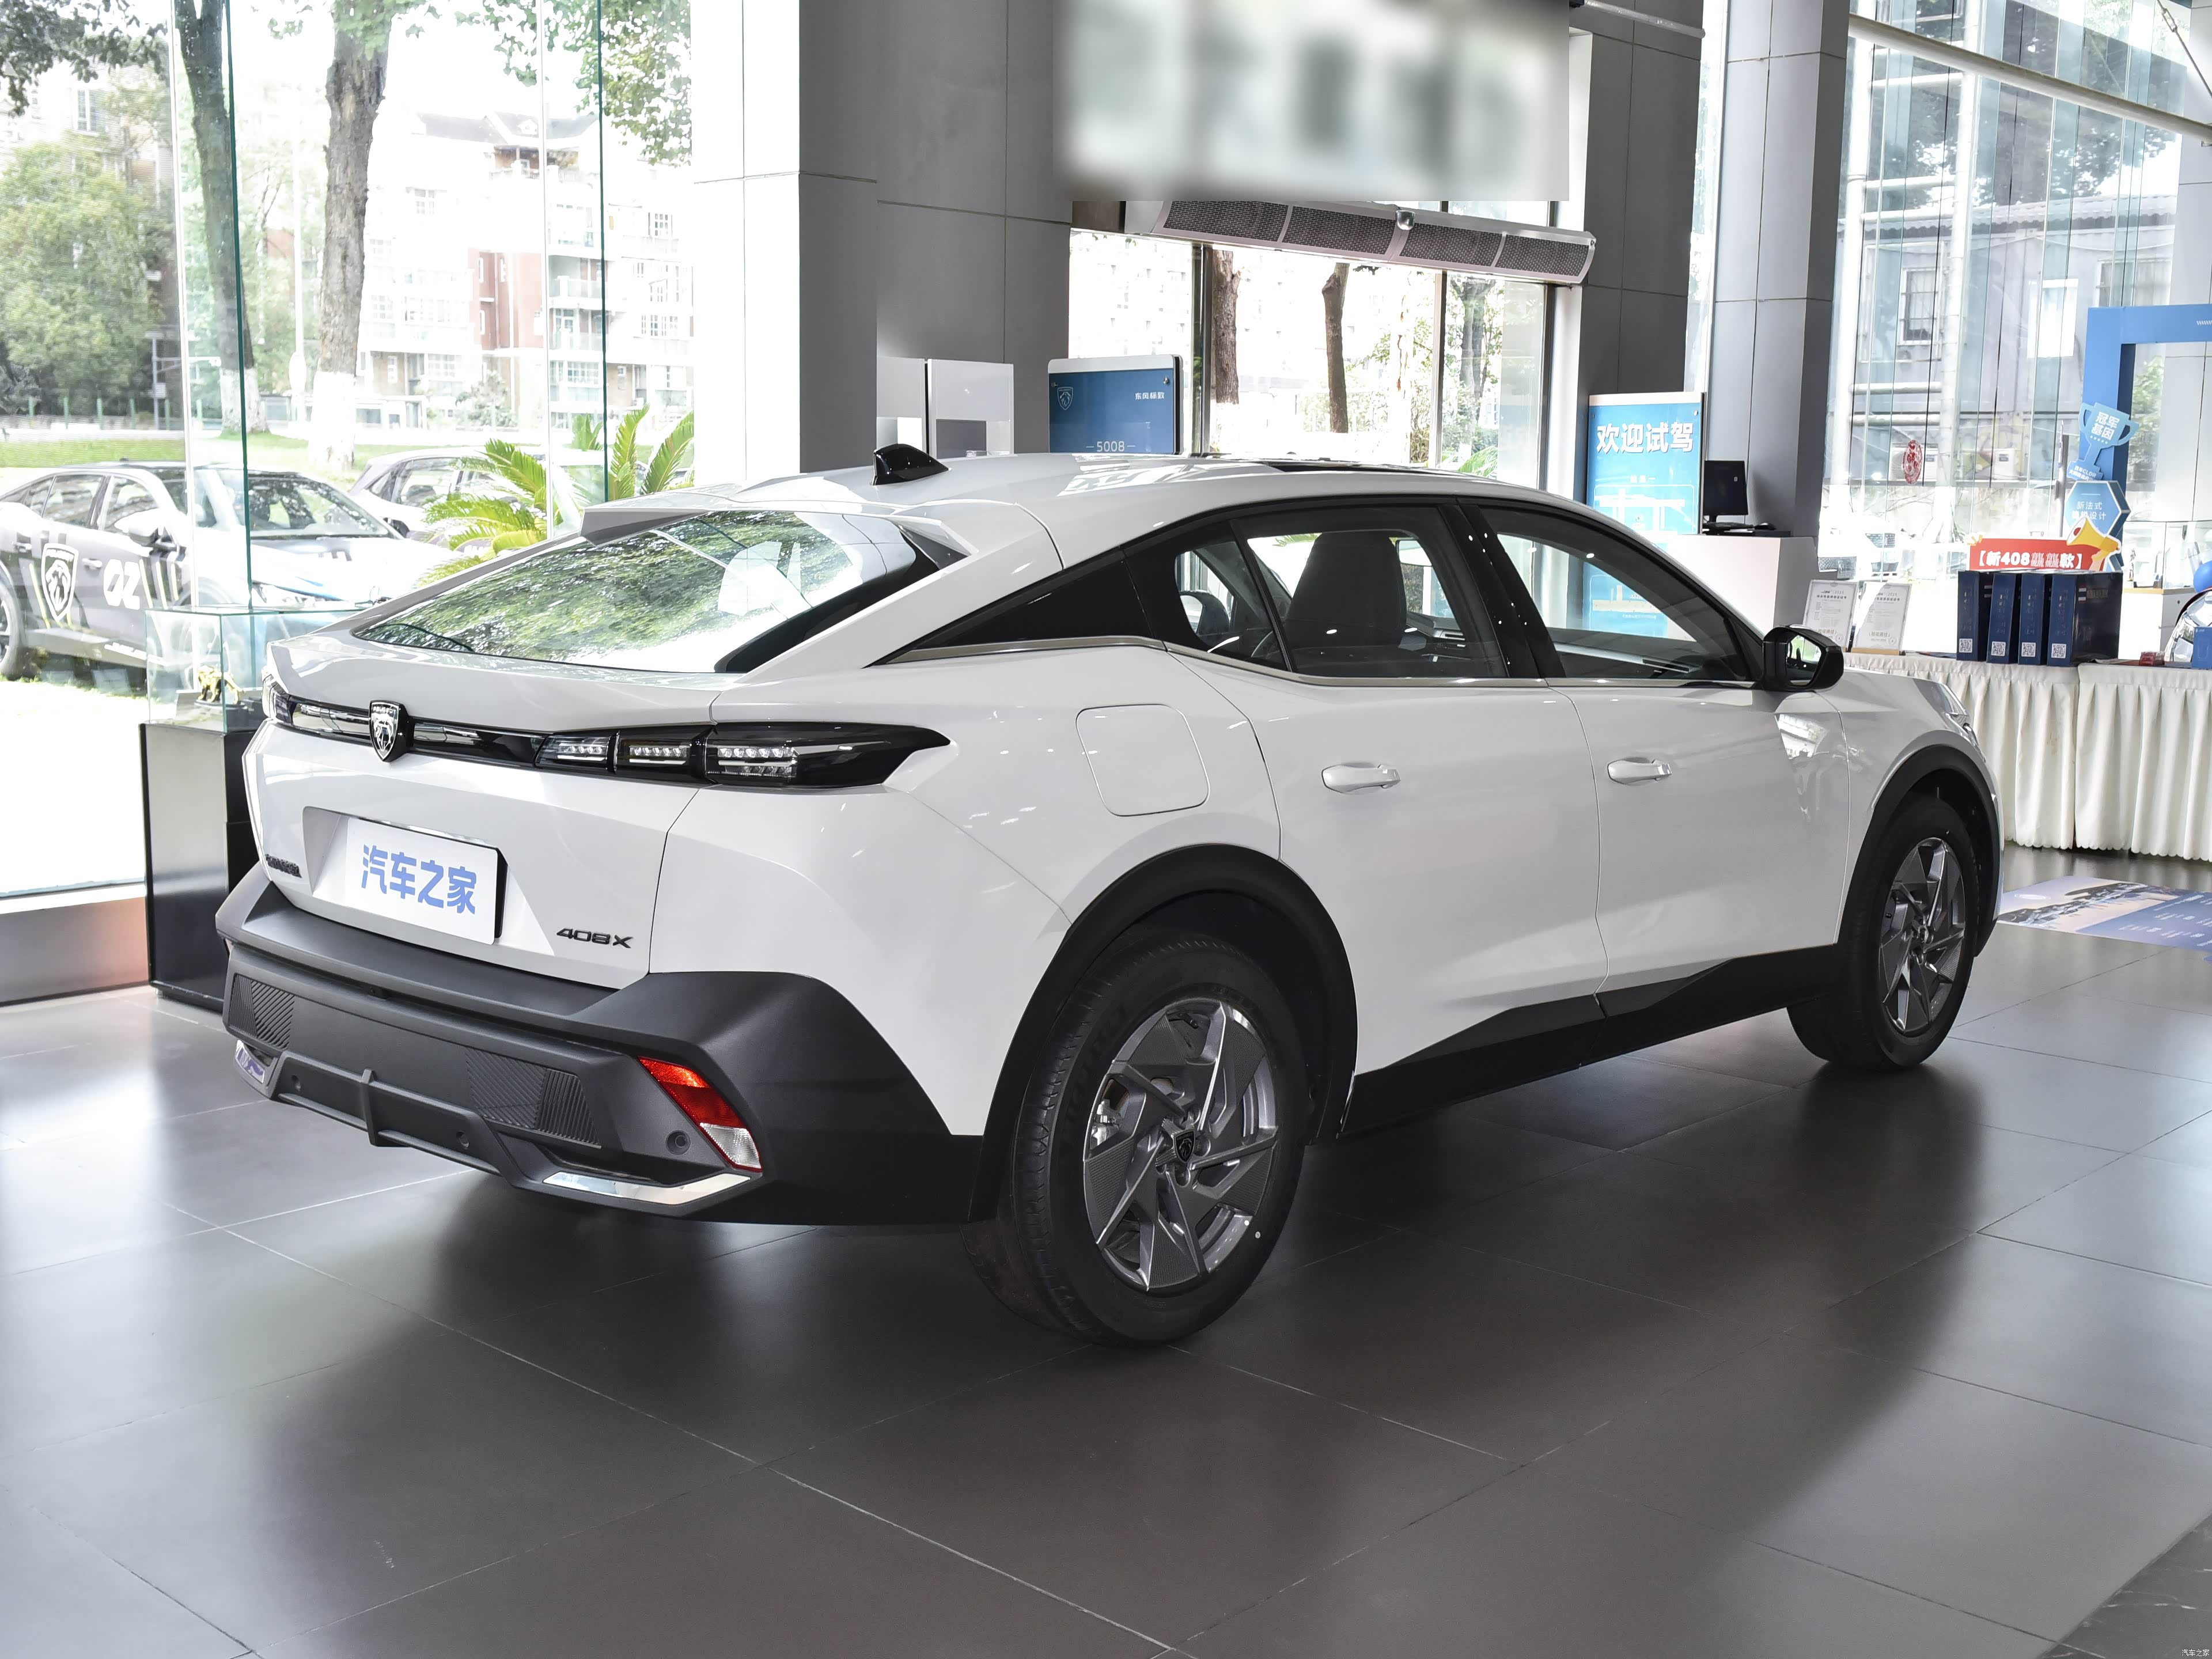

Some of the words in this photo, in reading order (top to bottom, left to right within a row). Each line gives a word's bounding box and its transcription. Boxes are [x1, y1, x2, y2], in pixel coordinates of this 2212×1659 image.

[1135, 392, 1165, 400] 东风标致
[2096, 411, 2120, 428] 冠军
[1596, 421, 1694, 453] 欢迎试驾
[2091, 423, 2115, 441] 基因
[1096, 440, 1125, 452] 5008
[2076, 501, 2103, 510] 新法式
[361, 844, 476, 915] 汽车之家
[556, 928, 633, 949] 408X
